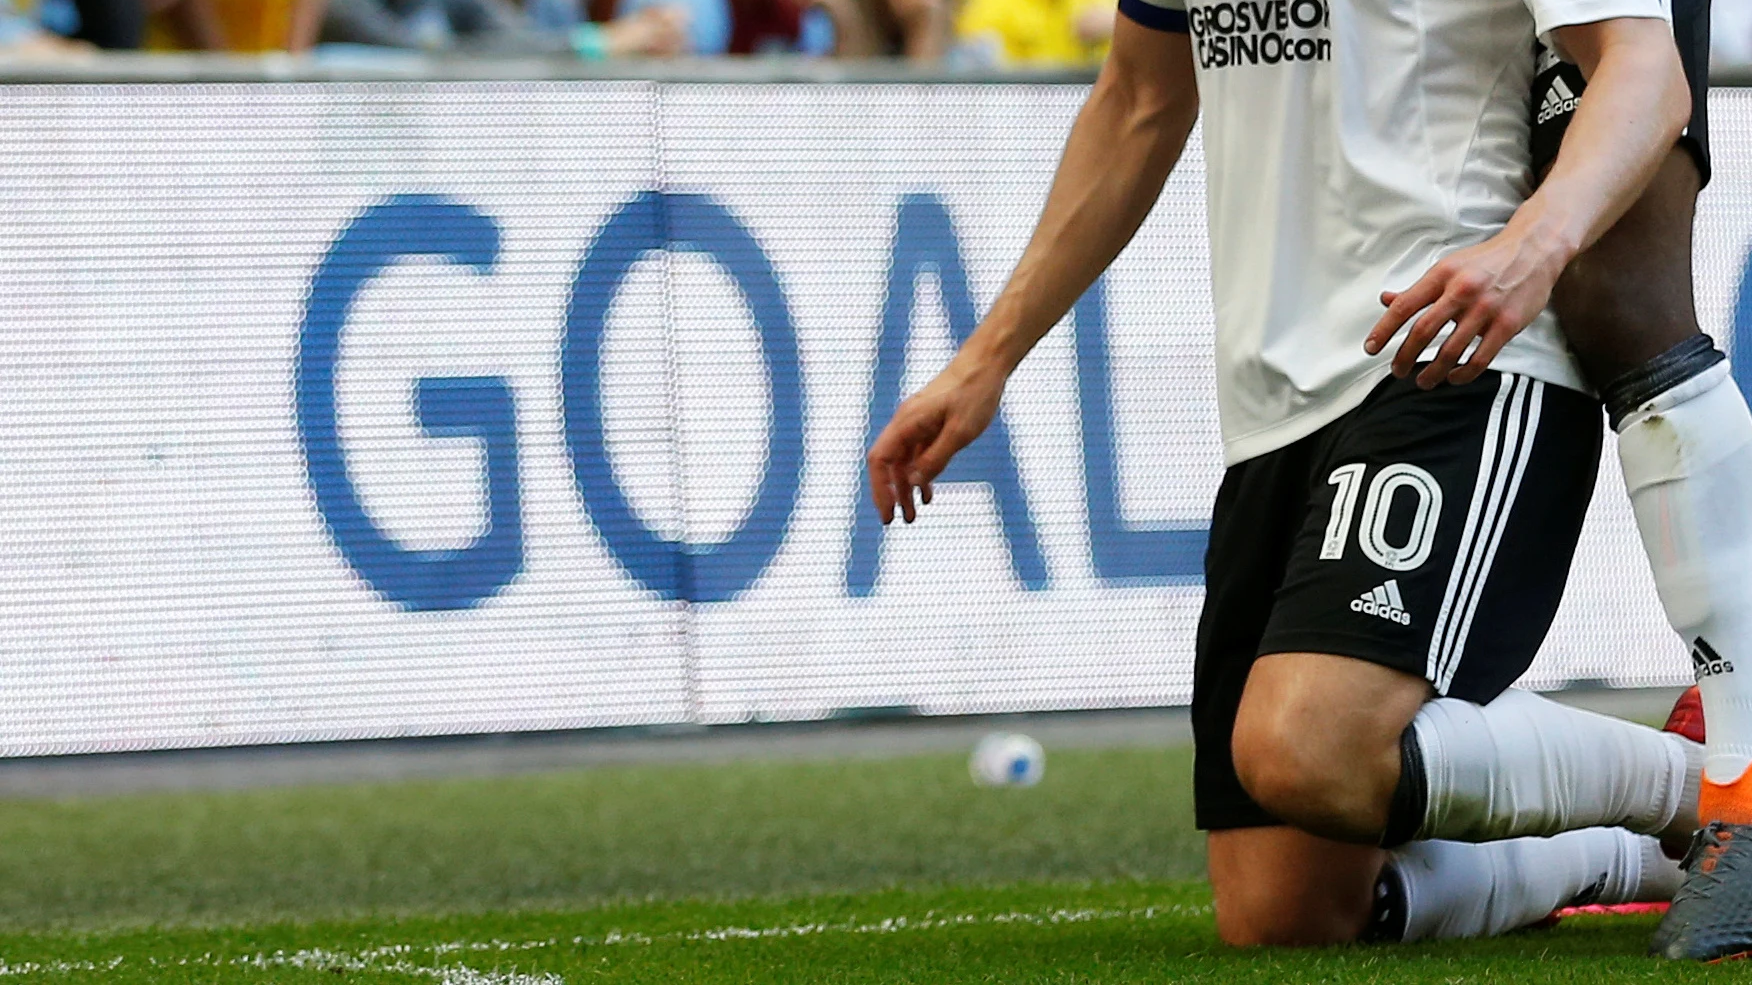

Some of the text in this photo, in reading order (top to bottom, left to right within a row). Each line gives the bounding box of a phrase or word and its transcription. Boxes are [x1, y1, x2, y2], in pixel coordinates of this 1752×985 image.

[1537, 96, 1582, 125] adidas
[293, 191, 1210, 612] GOAL
[1319, 463, 1443, 571] 10
[1349, 598, 1412, 626] adidas
